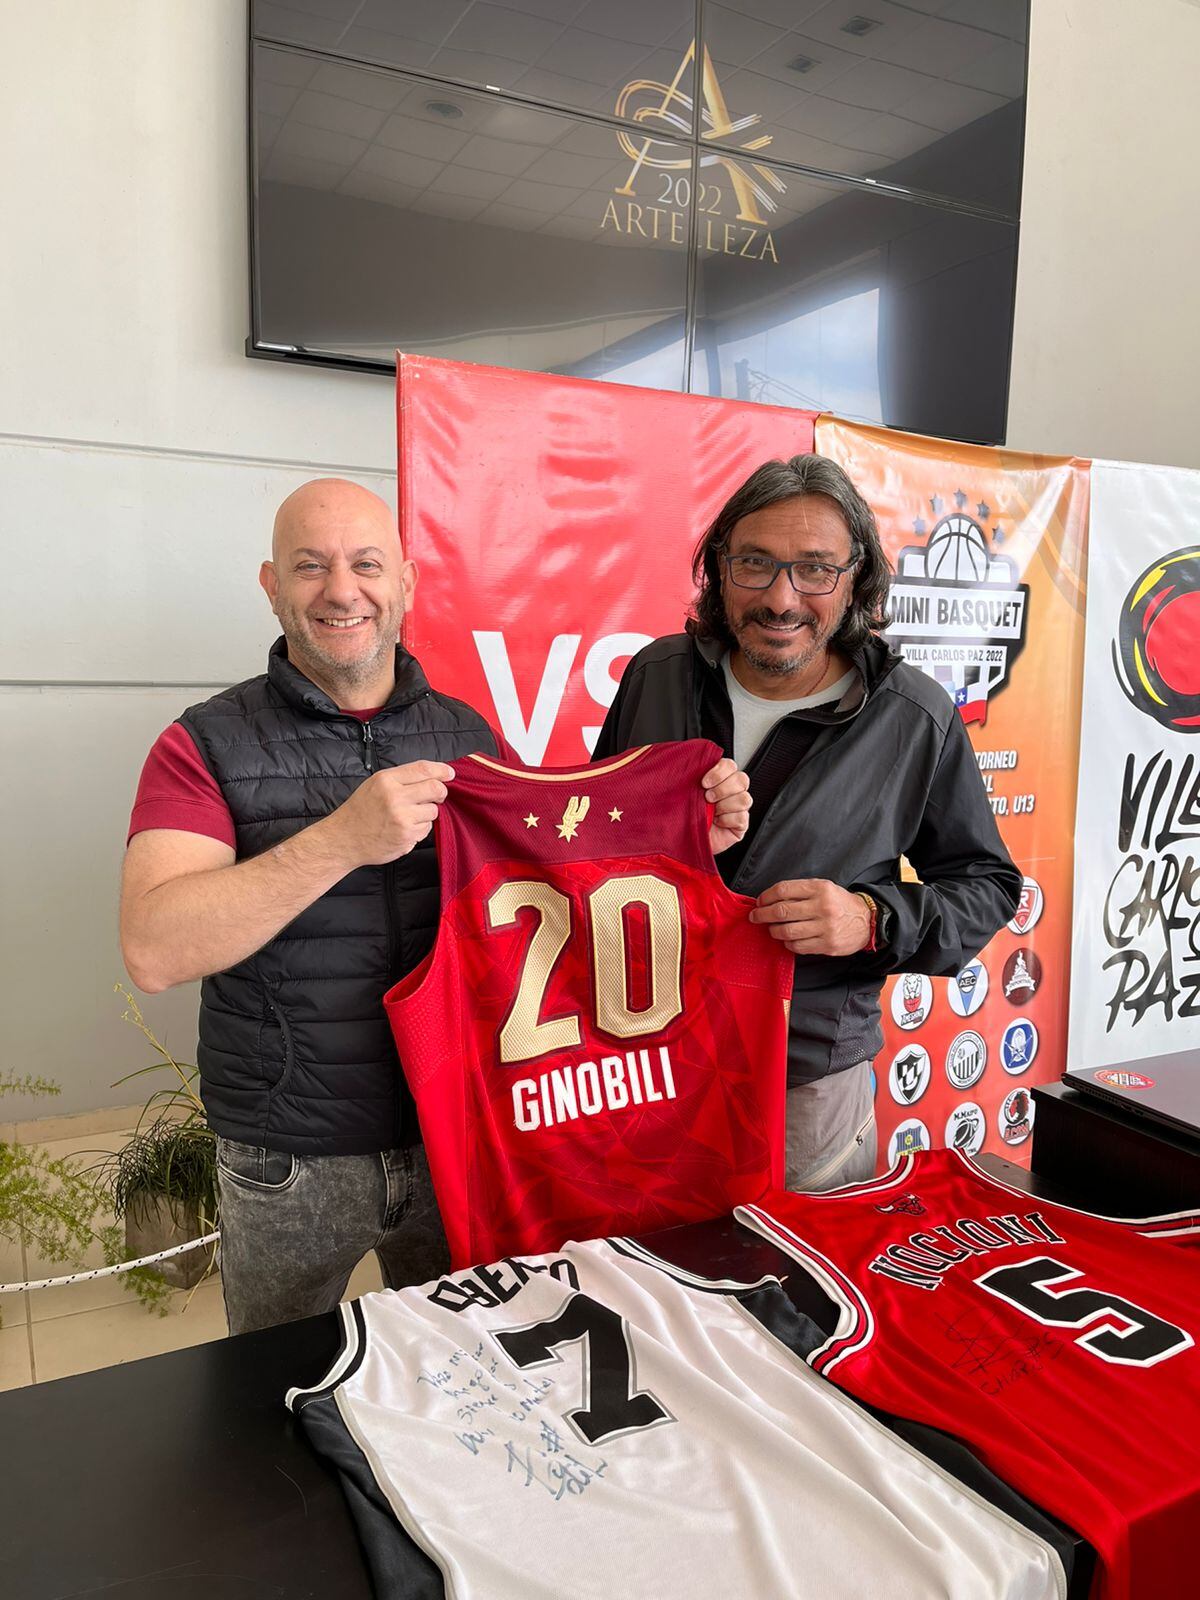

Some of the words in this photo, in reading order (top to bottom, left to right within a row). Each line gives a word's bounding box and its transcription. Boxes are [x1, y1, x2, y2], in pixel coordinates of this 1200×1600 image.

[890, 595, 930, 625] MINI
[937, 598, 1022, 632] BASQUET
[905, 648, 929, 661] VILLA
[931, 649, 965, 661] CARLOS
[967, 649, 984, 662] PAZ
[985, 650, 1003, 662] 2022
[1013, 793, 1036, 814] U13
[487, 872, 685, 1066] 20
[511, 1046, 677, 1132] GINOBILI
[867, 1211, 1067, 1291] NOCIONI
[972, 1255, 1196, 1369] 5
[486, 1292, 680, 1447] 7
